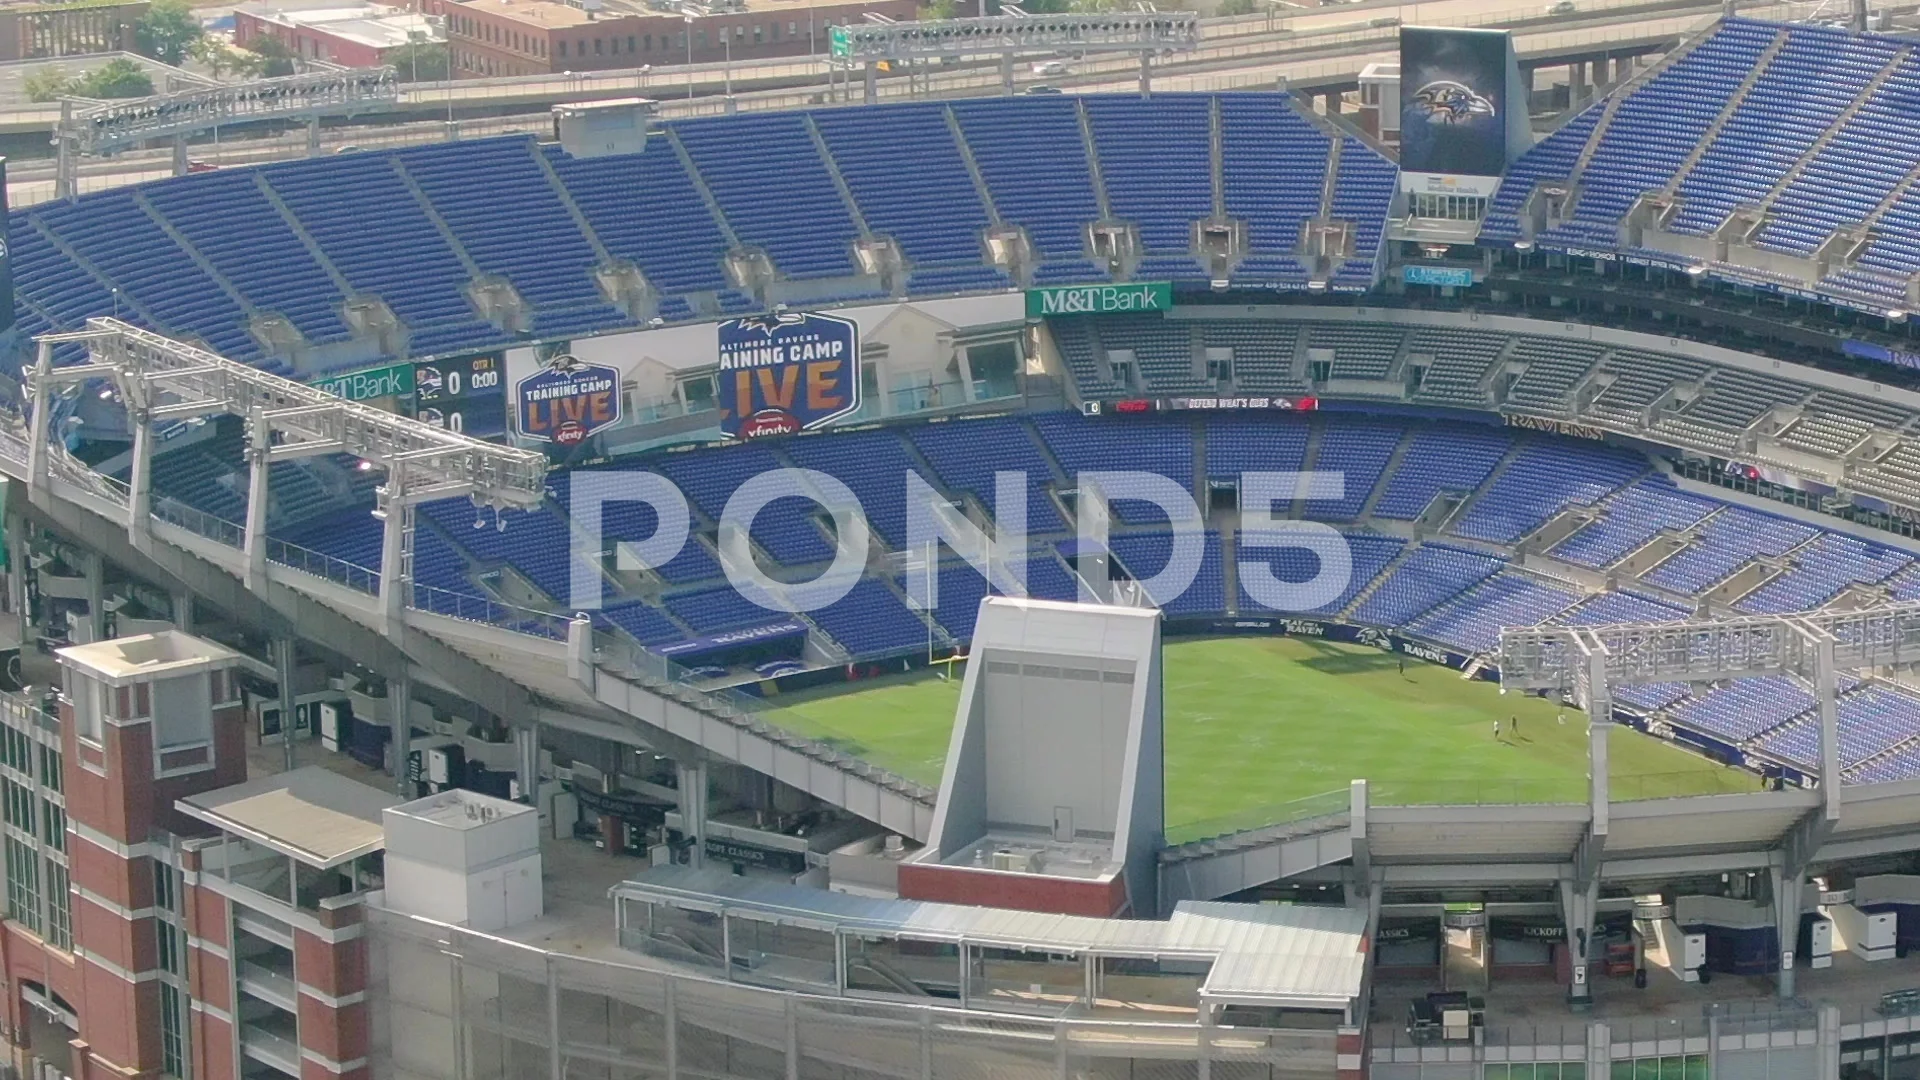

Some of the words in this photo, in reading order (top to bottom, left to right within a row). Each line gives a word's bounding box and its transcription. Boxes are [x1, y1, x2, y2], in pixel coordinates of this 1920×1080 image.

[1040, 288, 1100, 314] M&T
[1102, 286, 1158, 311] Bank
[790, 340, 843, 361] CAMP
[353, 368, 402, 401] Bank
[448, 371, 461, 395] 0
[471, 371, 498, 389] 0:00
[526, 385, 578, 401] TRAINING
[580, 379, 612, 394] CAMP
[450, 412, 463, 433] 0
[528, 391, 611, 432] LIVE
[1501, 411, 1605, 441] RAVENS
[1402, 642, 1448, 665] RAVENS
